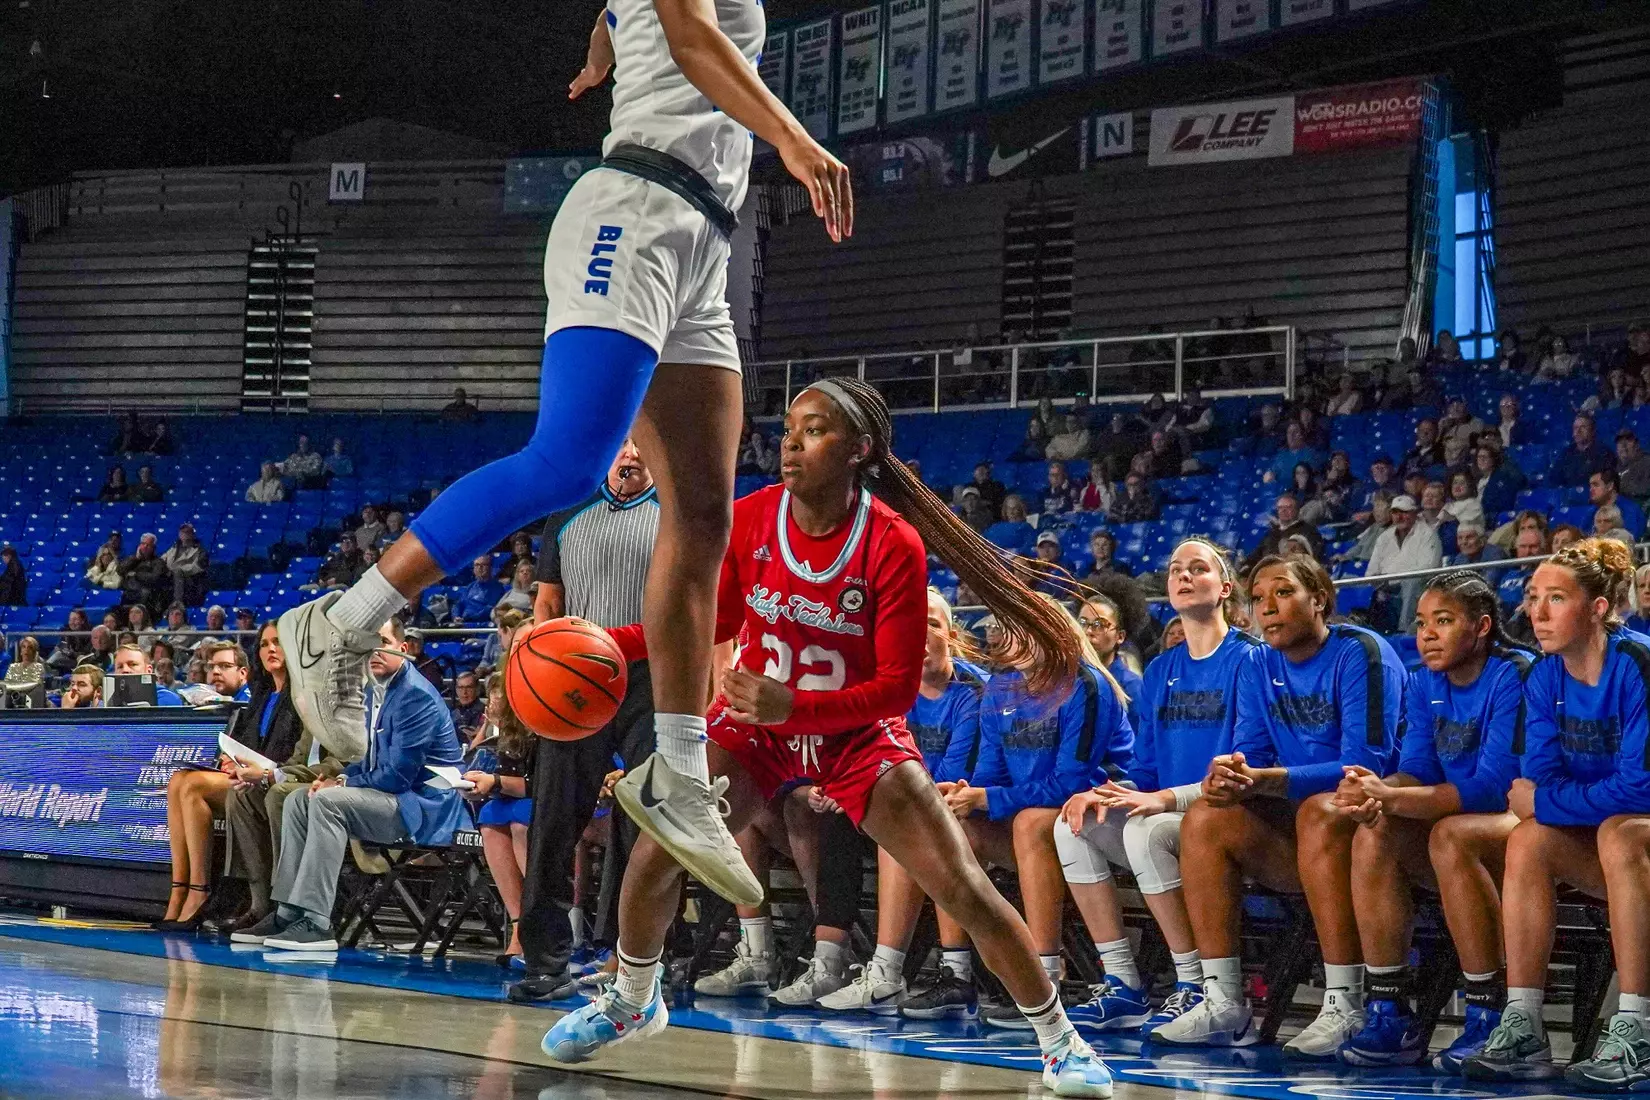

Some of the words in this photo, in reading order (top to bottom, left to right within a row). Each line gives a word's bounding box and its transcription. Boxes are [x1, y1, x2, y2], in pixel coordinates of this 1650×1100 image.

[1104, 121, 1125, 148] N
[1207, 108, 1278, 140] LEE
[1202, 138, 1264, 151] COMPANY
[336, 170, 359, 192] M
[584, 225, 623, 296] BLUE
[746, 583, 784, 625] Lady
[781, 593, 866, 636] Techsters
[39, 783, 109, 828] Report
[456, 832, 474, 847] BLUE
